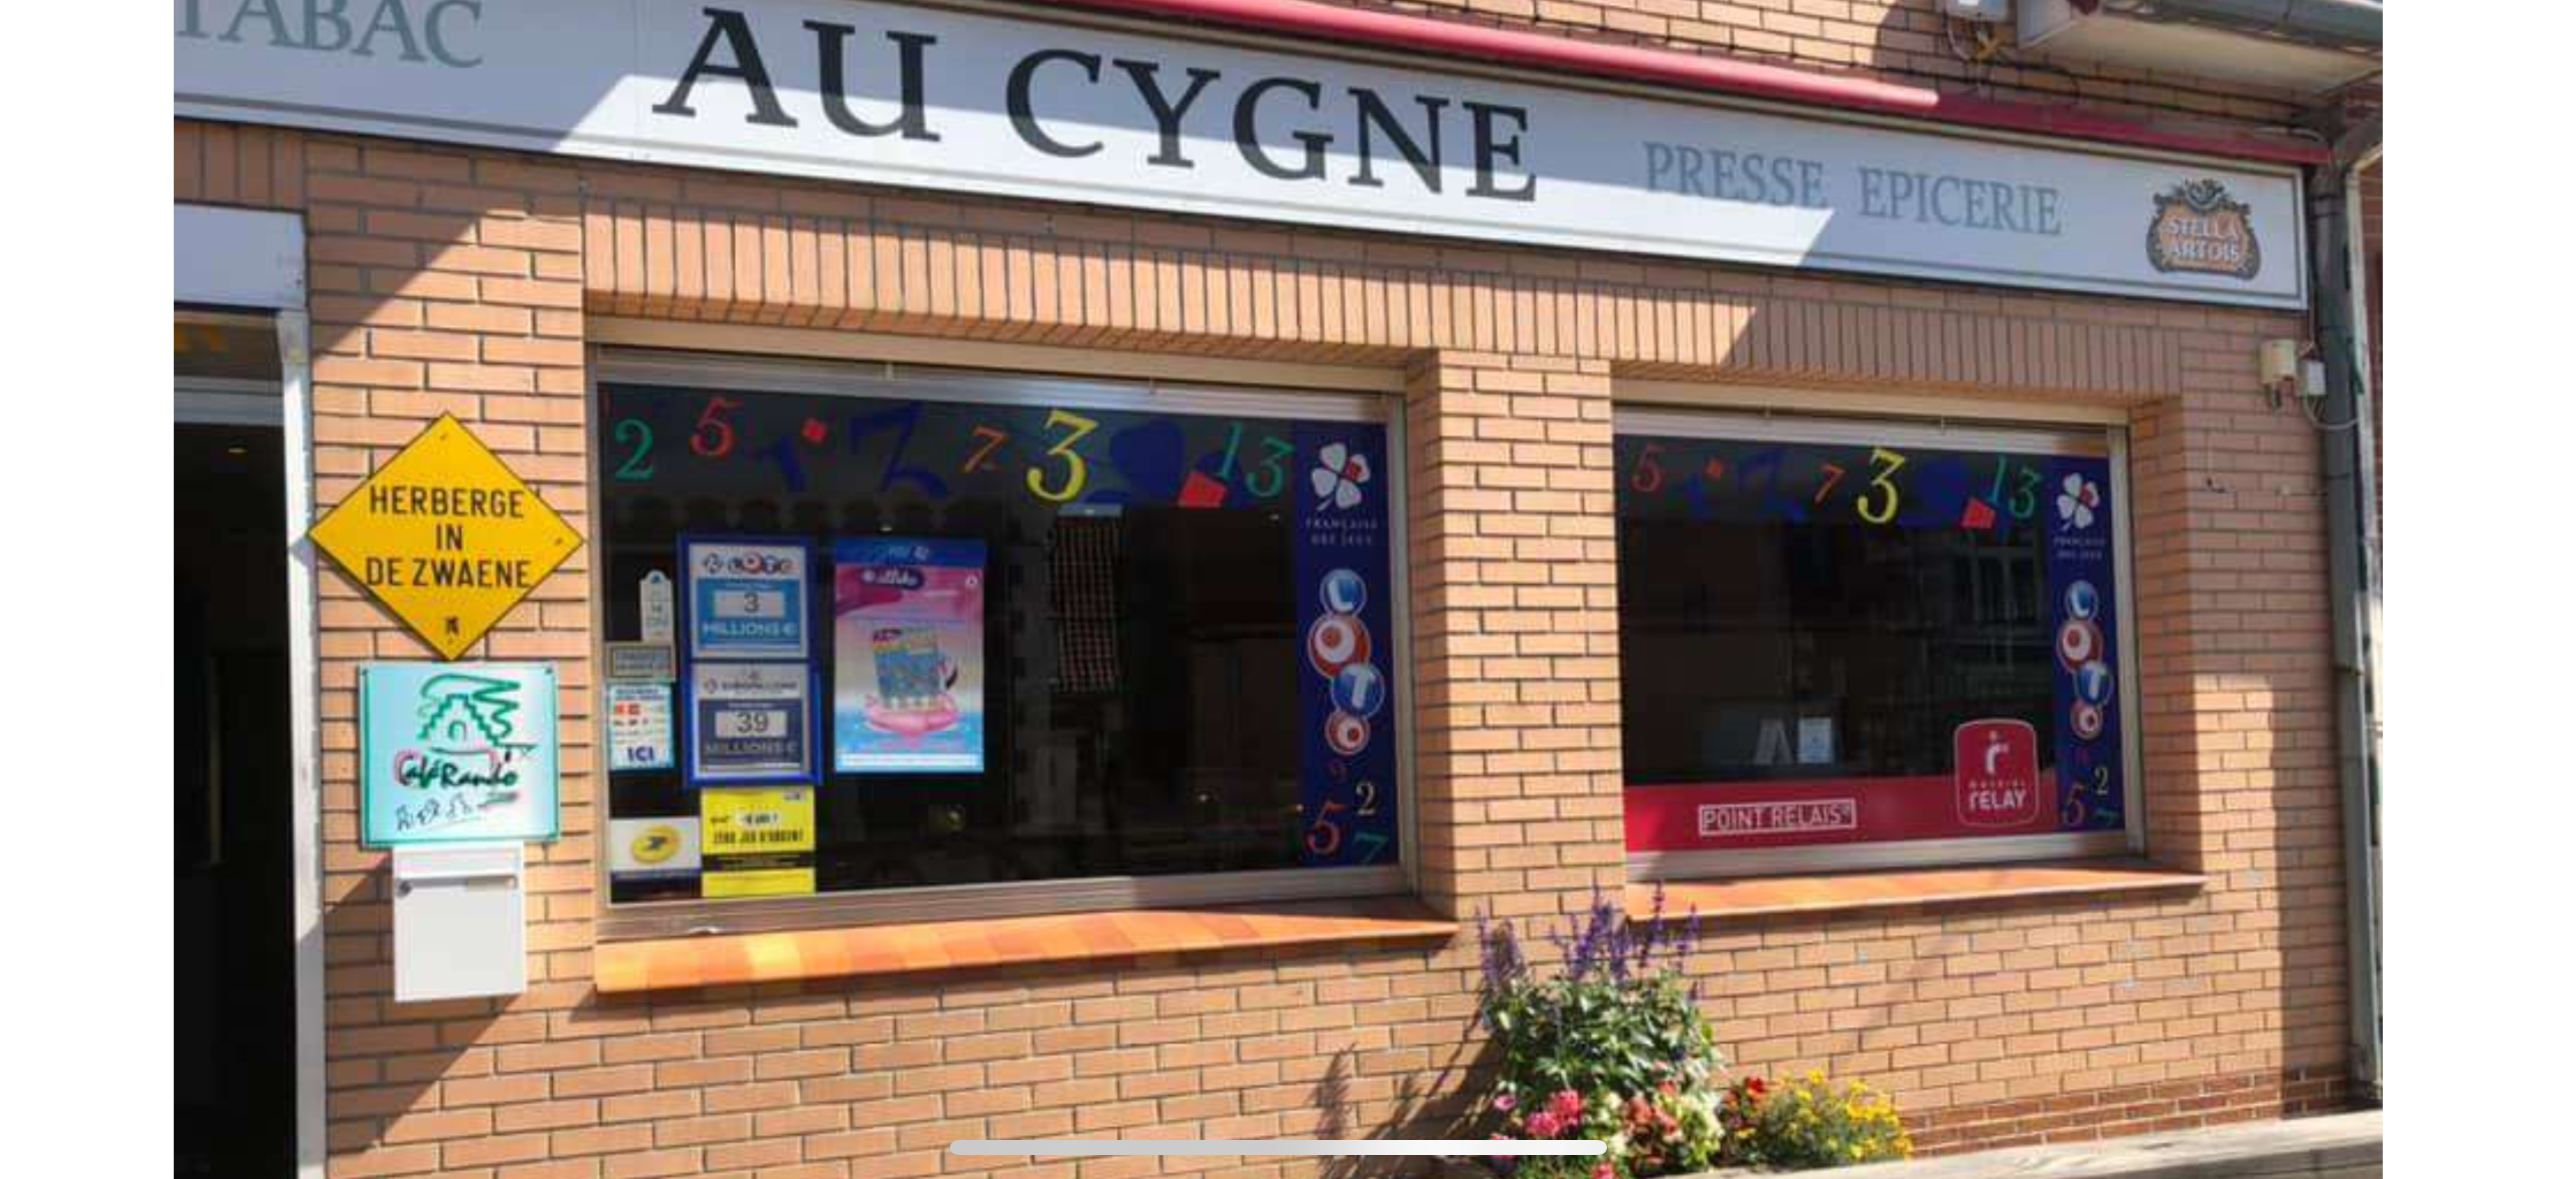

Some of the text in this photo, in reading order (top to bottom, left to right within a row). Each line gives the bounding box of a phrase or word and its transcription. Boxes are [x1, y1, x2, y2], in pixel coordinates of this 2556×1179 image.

[651, 6, 1537, 203] AU CYGNE
[1642, 140, 2063, 237] PRESSE EPICERIE
[2165, 216, 2240, 239] STELLA
[2164, 241, 2240, 262] ARTOIS
[614, 418, 654, 482] 2
[690, 397, 743, 457] 5
[1026, 409, 1098, 502] 3
[1632, 443, 1666, 492] 5
[1813, 463, 1846, 505] 7
[1857, 446, 1906, 524] 3
[369, 485, 525, 519] HERBERGE
[435, 524, 464, 551] IN
[366, 557, 531, 589] DE ZWAENE
[743, 591, 760, 614] 3
[737, 711, 769, 734] 39
[1354, 779, 1377, 818] 2
[1306, 801, 1348, 855] 5
[1702, 806, 1763, 831] POINT
